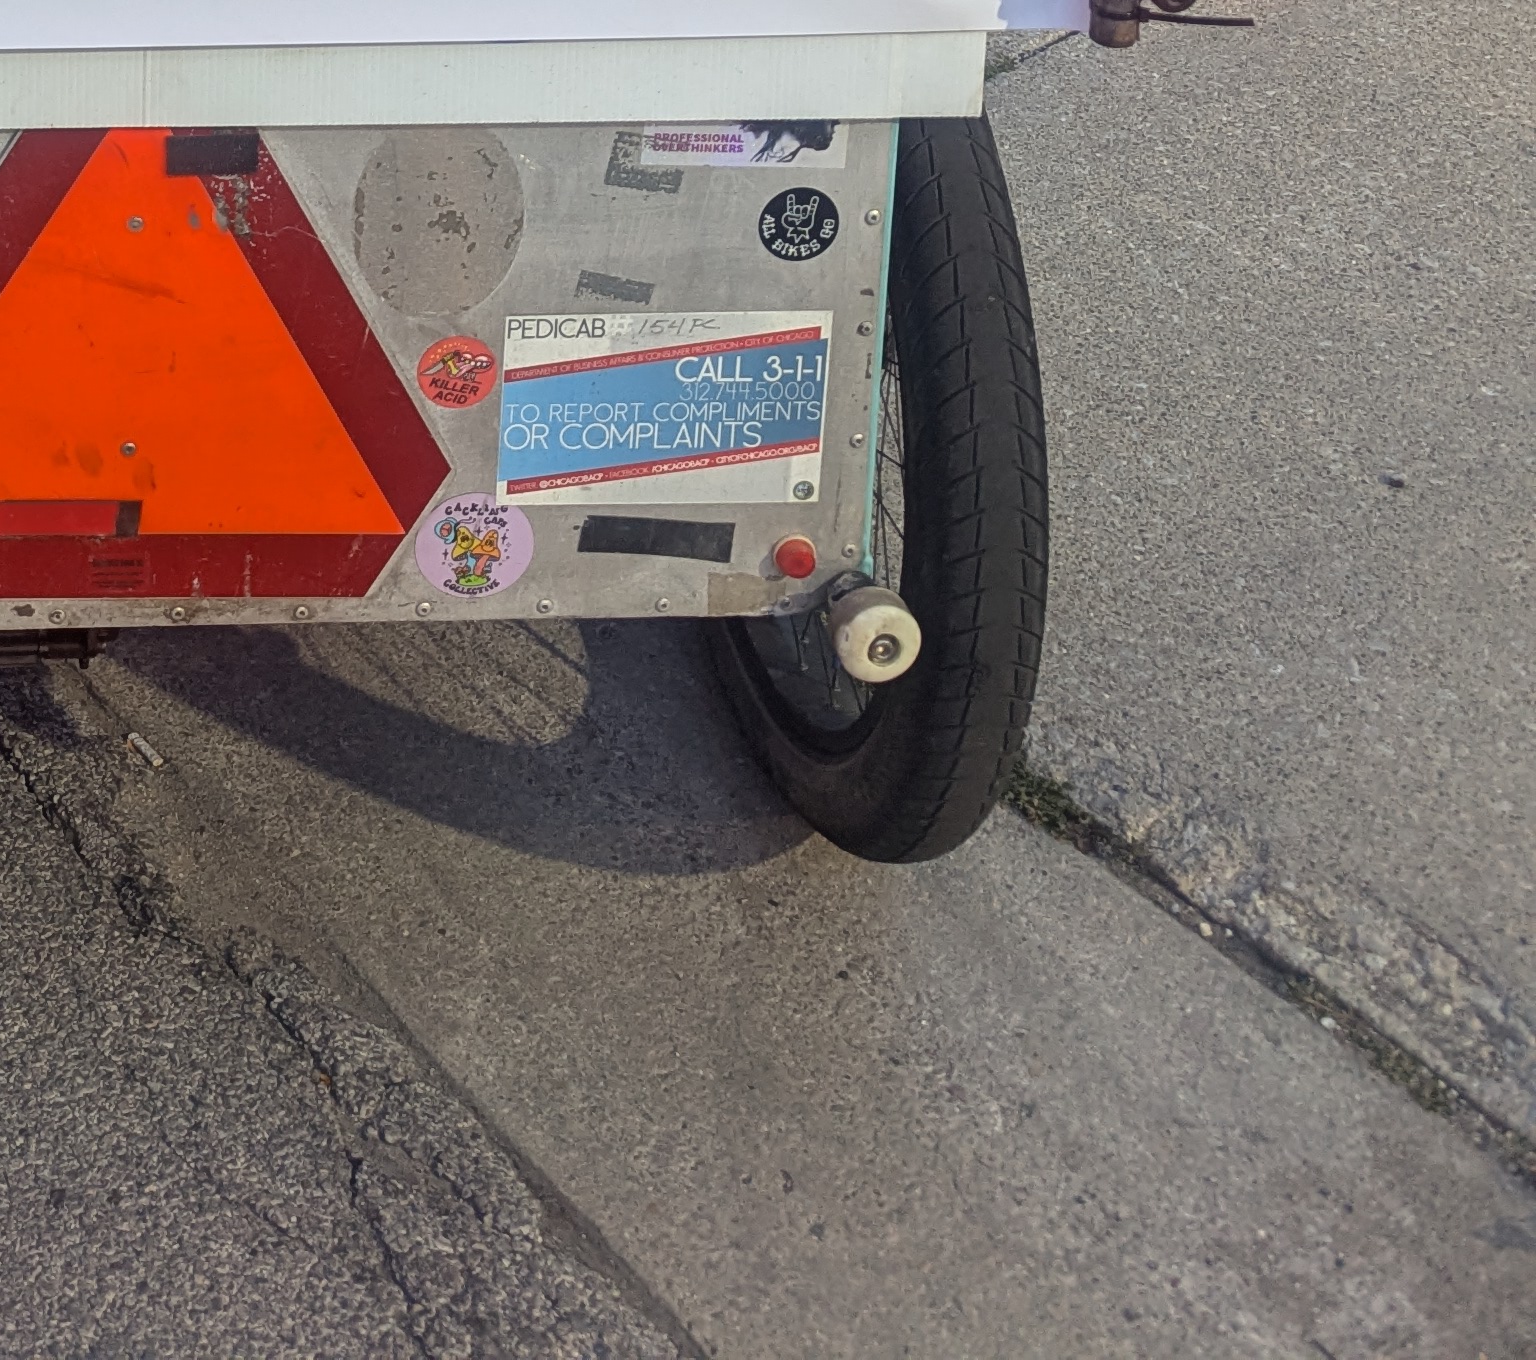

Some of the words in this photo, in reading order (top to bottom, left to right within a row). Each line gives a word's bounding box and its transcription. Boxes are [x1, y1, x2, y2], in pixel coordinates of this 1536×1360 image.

[654, 132, 744, 143] PROFESSIONAL
[653, 142, 744, 153] OVERTHINKERS
[762, 214, 776, 239] ALL
[772, 238, 821, 257] BIKES
[819, 218, 835, 239] GO
[507, 318, 606, 339] PEDICAB
[511, 365, 558, 379] DEPARTMENT
[560, 364, 573, 373] OF
[573, 359, 607, 371] BUSINESS
[609, 355, 636, 366] AFFAIRS
[637, 354, 644, 363] &
[645, 347, 690, 362] CONSUMER
[692, 341, 739, 354] PROTECTION
[744, 338, 761, 347] CITY
[763, 336, 774, 344] OF
[777, 331, 814, 342] CHICAGO
[674, 355, 753, 382] CALL
[763, 355, 823, 382] 3-1-1
[429, 377, 480, 396] KILLER
[679, 381, 815, 400] 312.744.5000
[432, 390, 468, 404] ACID
[506, 403, 540, 423] TO
[549, 402, 645, 423] REPORT
[653, 401, 821, 422] COMPLIMENTS
[503, 423, 549, 450] OR
[559, 421, 762, 450] COMPLAINTS
[445, 502, 508, 515] CACKLING
[484, 517, 508, 527] CAPS
[443, 579, 500, 595] COLLECTIVE
